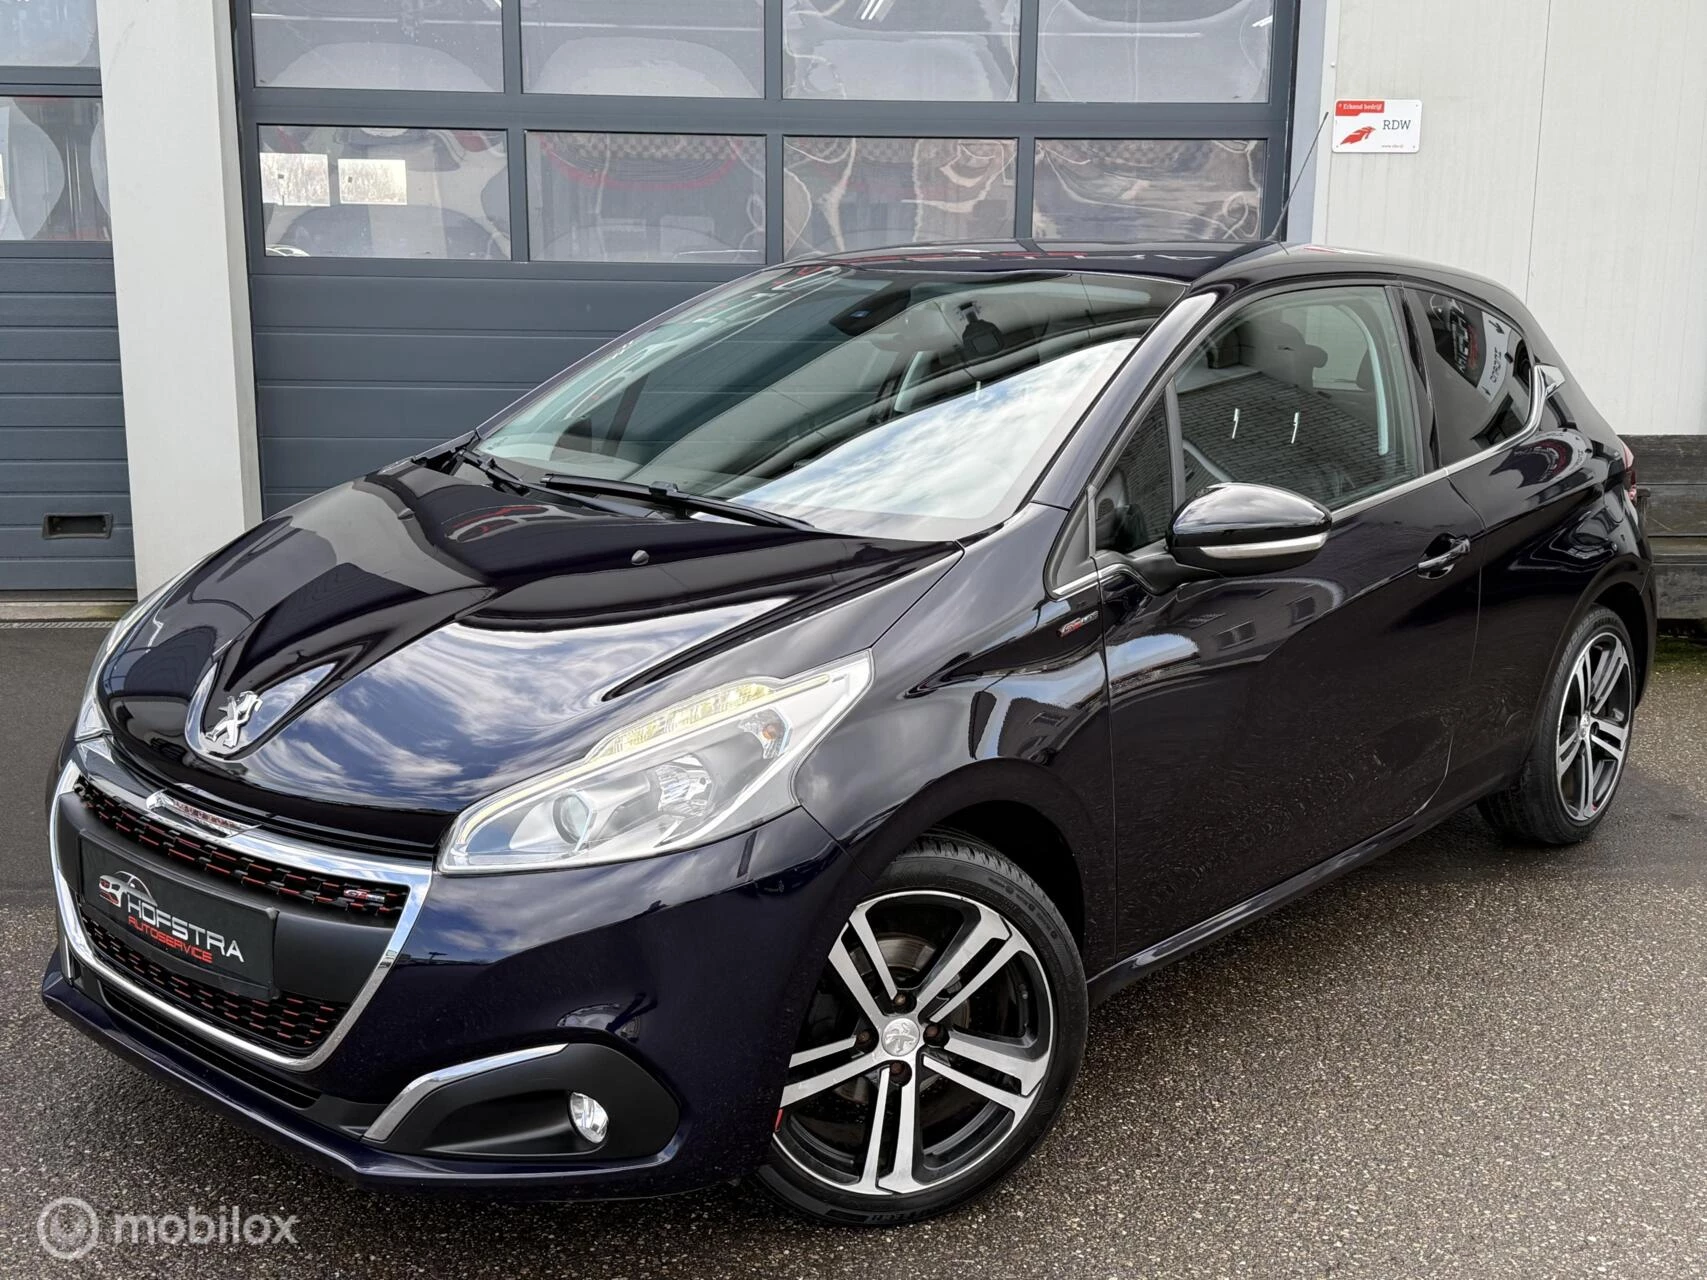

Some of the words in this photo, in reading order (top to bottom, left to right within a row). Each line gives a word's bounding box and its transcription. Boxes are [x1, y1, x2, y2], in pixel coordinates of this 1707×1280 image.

[1382, 119, 1411, 130] RDW
[127, 891, 245, 962] HOFSTRA
[128, 915, 214, 963] AUTOSERVICE
